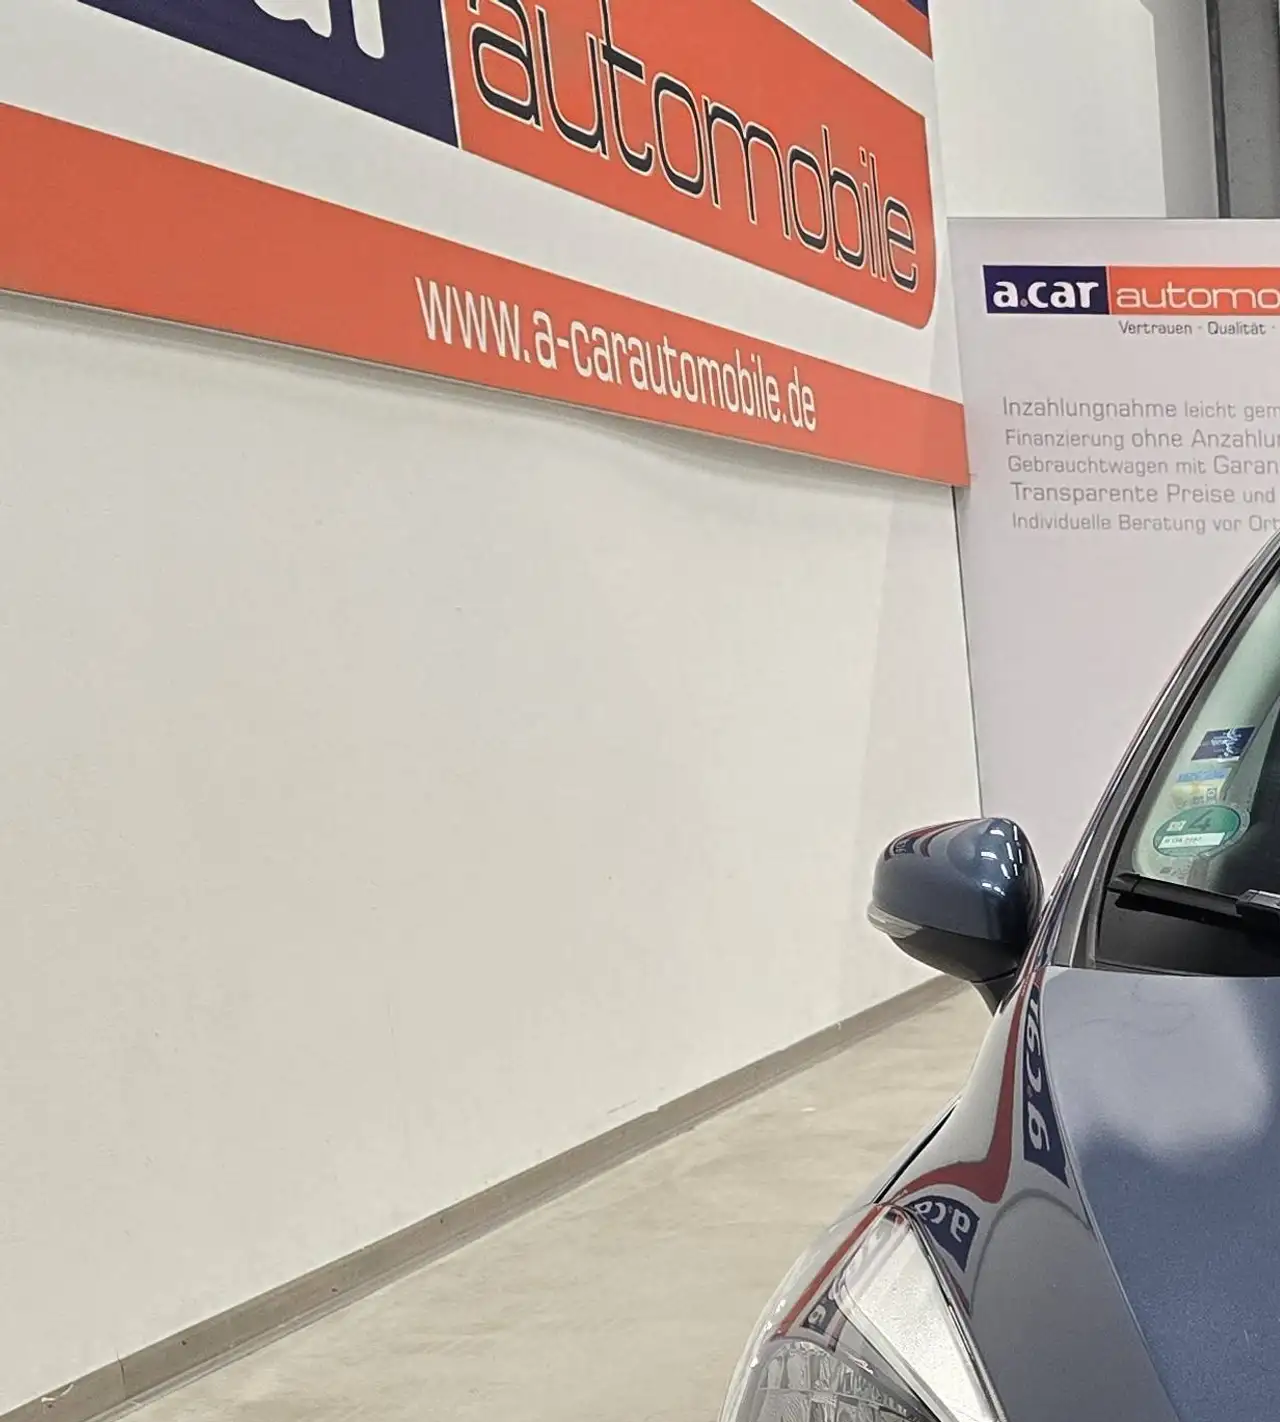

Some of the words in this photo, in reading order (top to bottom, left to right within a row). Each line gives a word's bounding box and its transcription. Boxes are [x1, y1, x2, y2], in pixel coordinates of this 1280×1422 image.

[469, 0, 919, 293] automobile
[992, 280, 1100, 309] a.car
[1118, 320, 1193, 335] Vertrauen
[1206, 320, 1266, 336] Qualität
[414, 276, 817, 432] www.a-carautomobile.de
[1002, 395, 1177, 421] Inzahlungnahme
[1184, 400, 1236, 419] leicht
[1005, 428, 1125, 450] Finanzierung
[1131, 428, 1183, 448] ohne
[1008, 455, 1168, 477] Gebrauchtwagen
[1175, 457, 1206, 475] mit
[1010, 482, 1159, 506] Transparente
[1166, 482, 1235, 503] Preise
[1242, 486, 1276, 503] und
[1012, 511, 1112, 530] Individuelle
[1118, 514, 1206, 535] Beratung
[1214, 518, 1242, 531] vor
